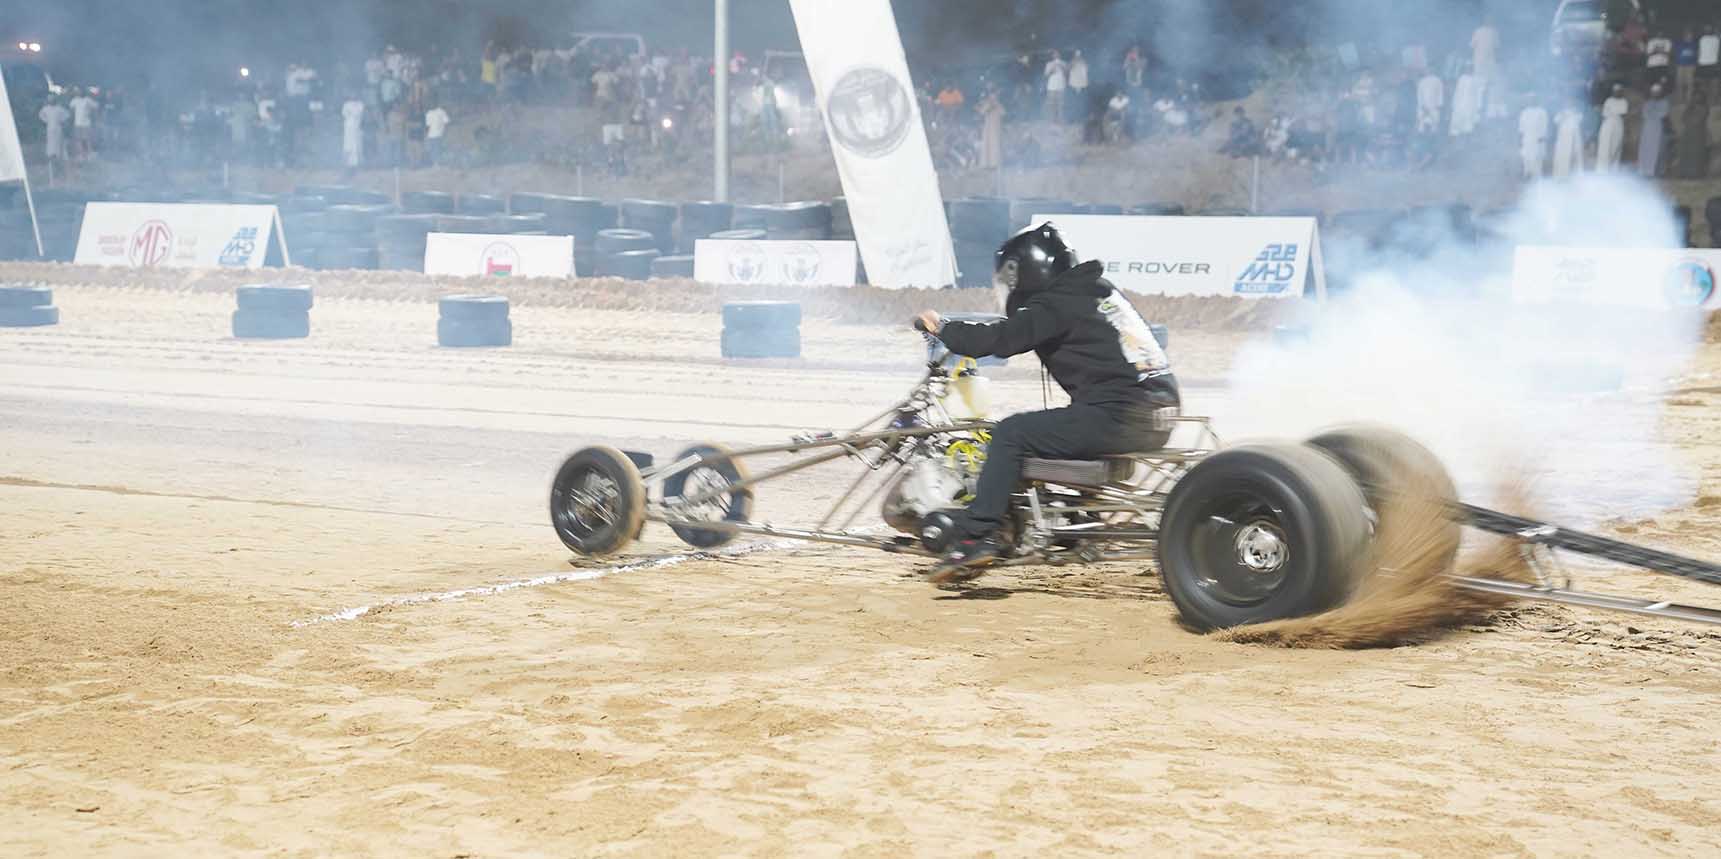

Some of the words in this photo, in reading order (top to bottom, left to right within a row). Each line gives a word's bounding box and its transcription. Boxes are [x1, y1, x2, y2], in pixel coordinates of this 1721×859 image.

[135, 225, 169, 265] MG
[1127, 261, 1211, 274] ROVER
[1236, 263, 1295, 281] MHD
